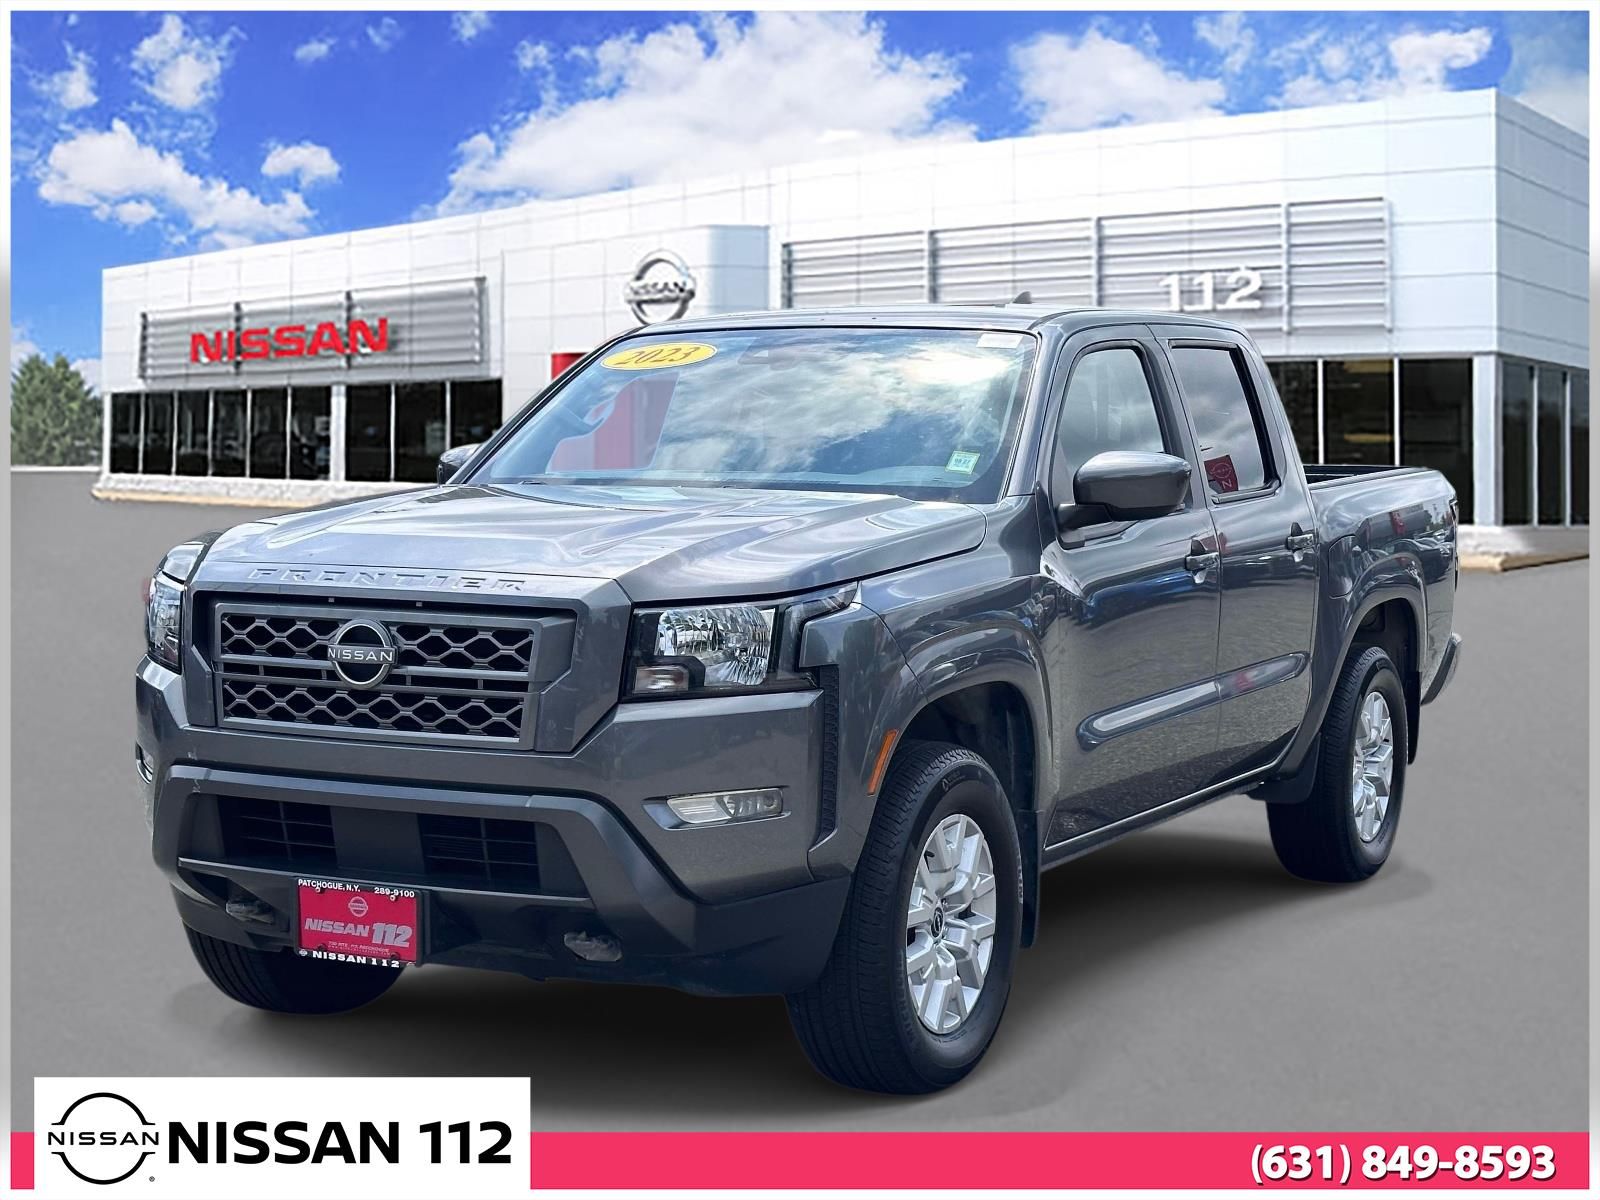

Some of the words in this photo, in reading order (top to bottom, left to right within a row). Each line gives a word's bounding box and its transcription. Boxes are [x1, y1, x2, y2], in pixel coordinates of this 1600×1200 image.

[1159, 270, 1263, 312] 112
[190, 317, 389, 363] NISSAN
[613, 346, 700, 365] 2023
[248, 568, 526, 592] FRONTIER
[327, 647, 393, 662] NISSAN
[346, 884, 360, 892] N.Y.
[374, 886, 415, 898] 289-9100
[304, 918, 370, 937] NISSAN
[372, 922, 413, 948] 112
[312, 950, 367, 964] NISSAN
[371, 957, 400, 968] 112
